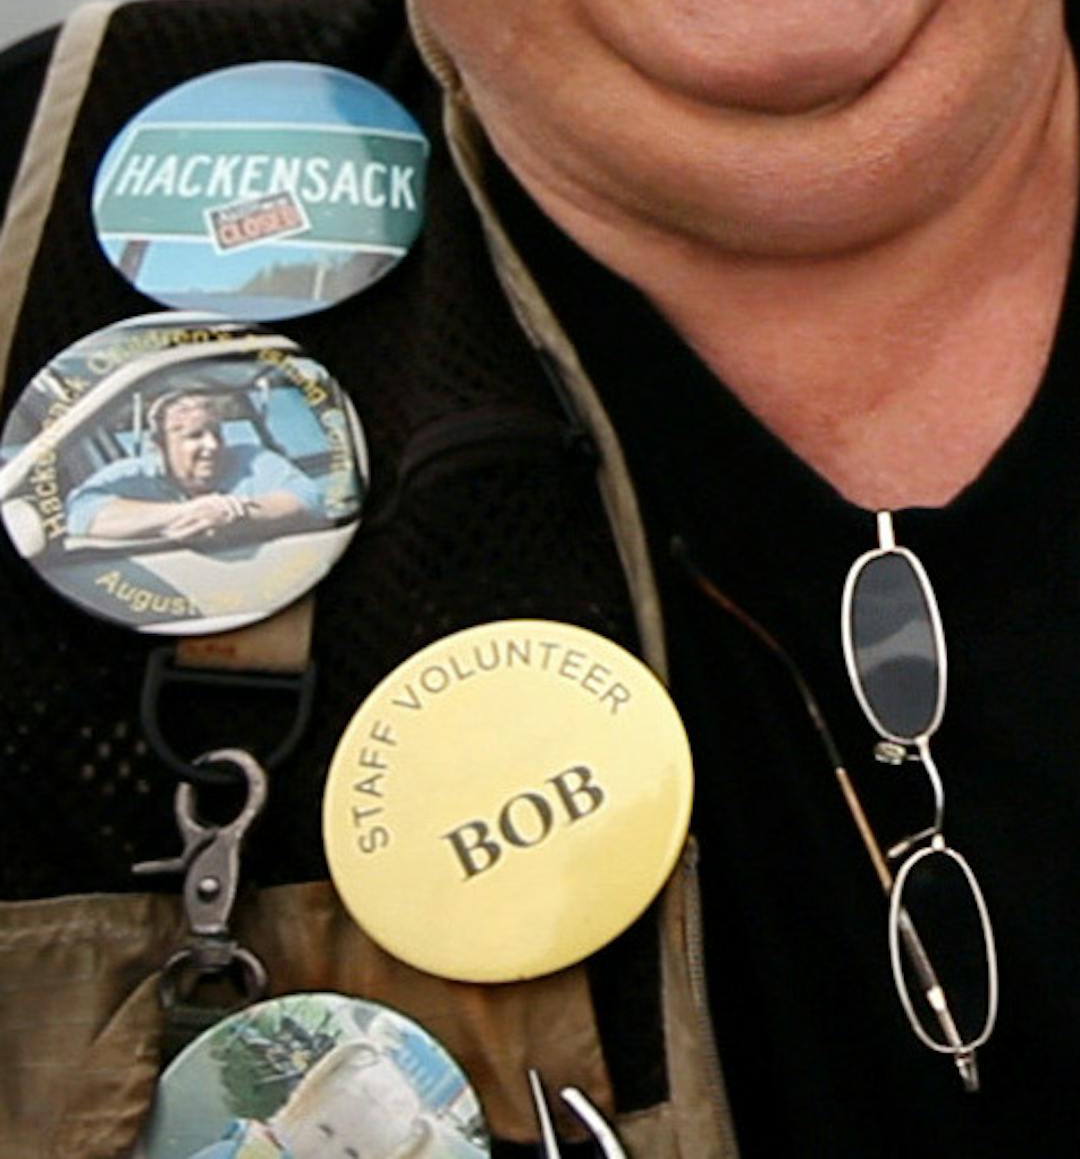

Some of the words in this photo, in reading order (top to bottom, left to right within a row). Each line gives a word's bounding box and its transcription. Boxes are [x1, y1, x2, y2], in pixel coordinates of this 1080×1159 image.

[115, 154, 418, 211] HACKENSACK
[30, 376, 91, 539] Hackeack
[96, 570, 198, 616] August
[352, 720, 397, 854] STAFF
[392, 640, 632, 715] VOLUNTEER
[441, 765, 606, 882] BOB
